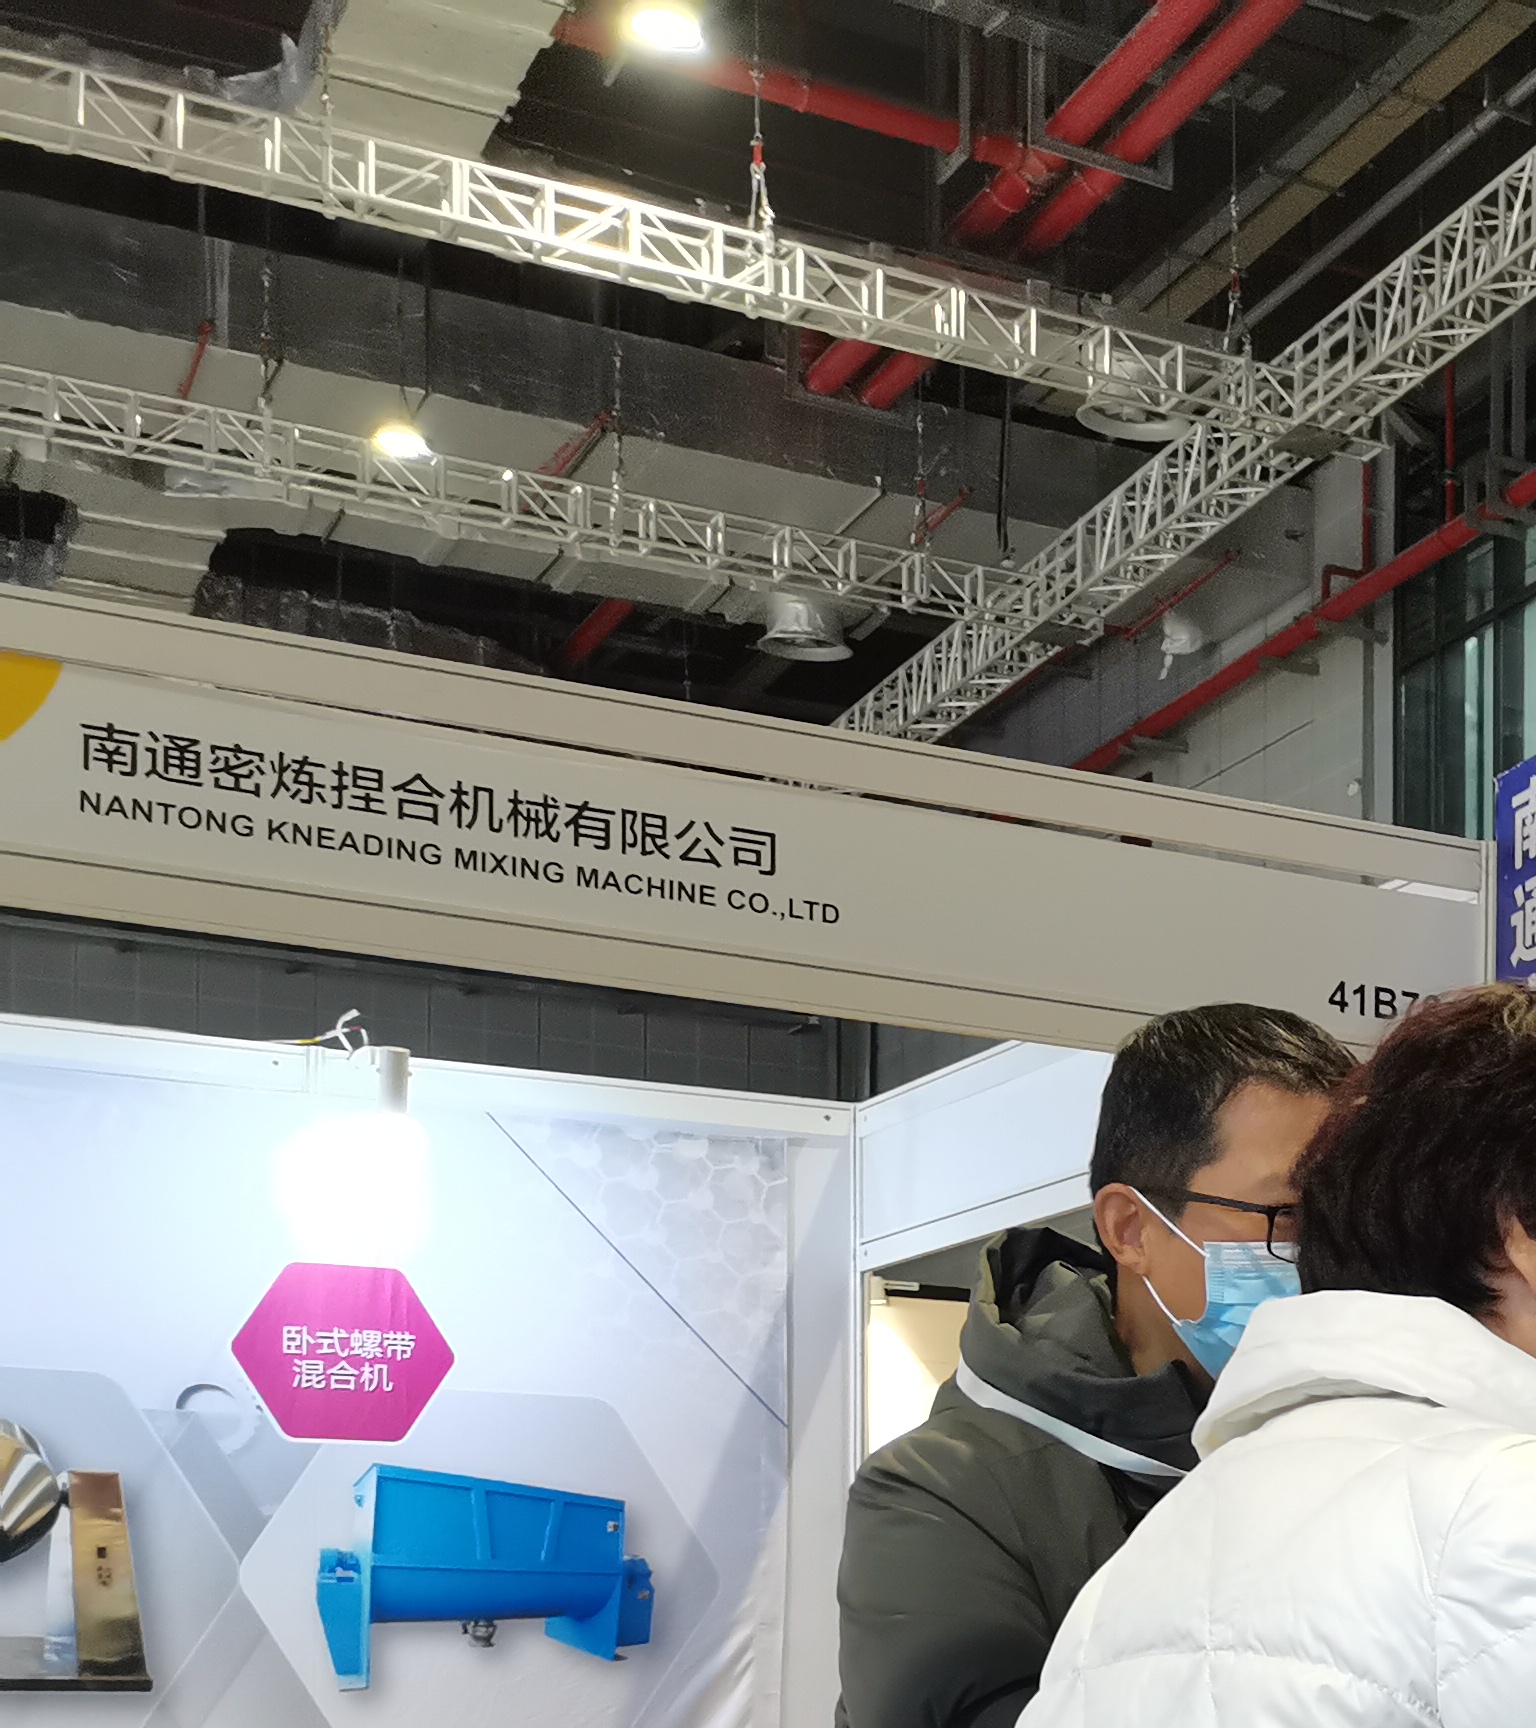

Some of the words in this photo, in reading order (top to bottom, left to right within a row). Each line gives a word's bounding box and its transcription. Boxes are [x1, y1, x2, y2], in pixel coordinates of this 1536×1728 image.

[79, 721, 778, 877] 南通密炼捏合机械有限公司
[79, 789, 256, 840] NANTONG
[267, 818, 442, 865] KNEADING
[454, 848, 565, 885] MIXING
[576, 863, 718, 910] MACHINE
[726, 887, 841, 926] CO.,LTD
[282, 1325, 416, 1361] 卧式螺带
[292, 1358, 394, 1392] 混合机
